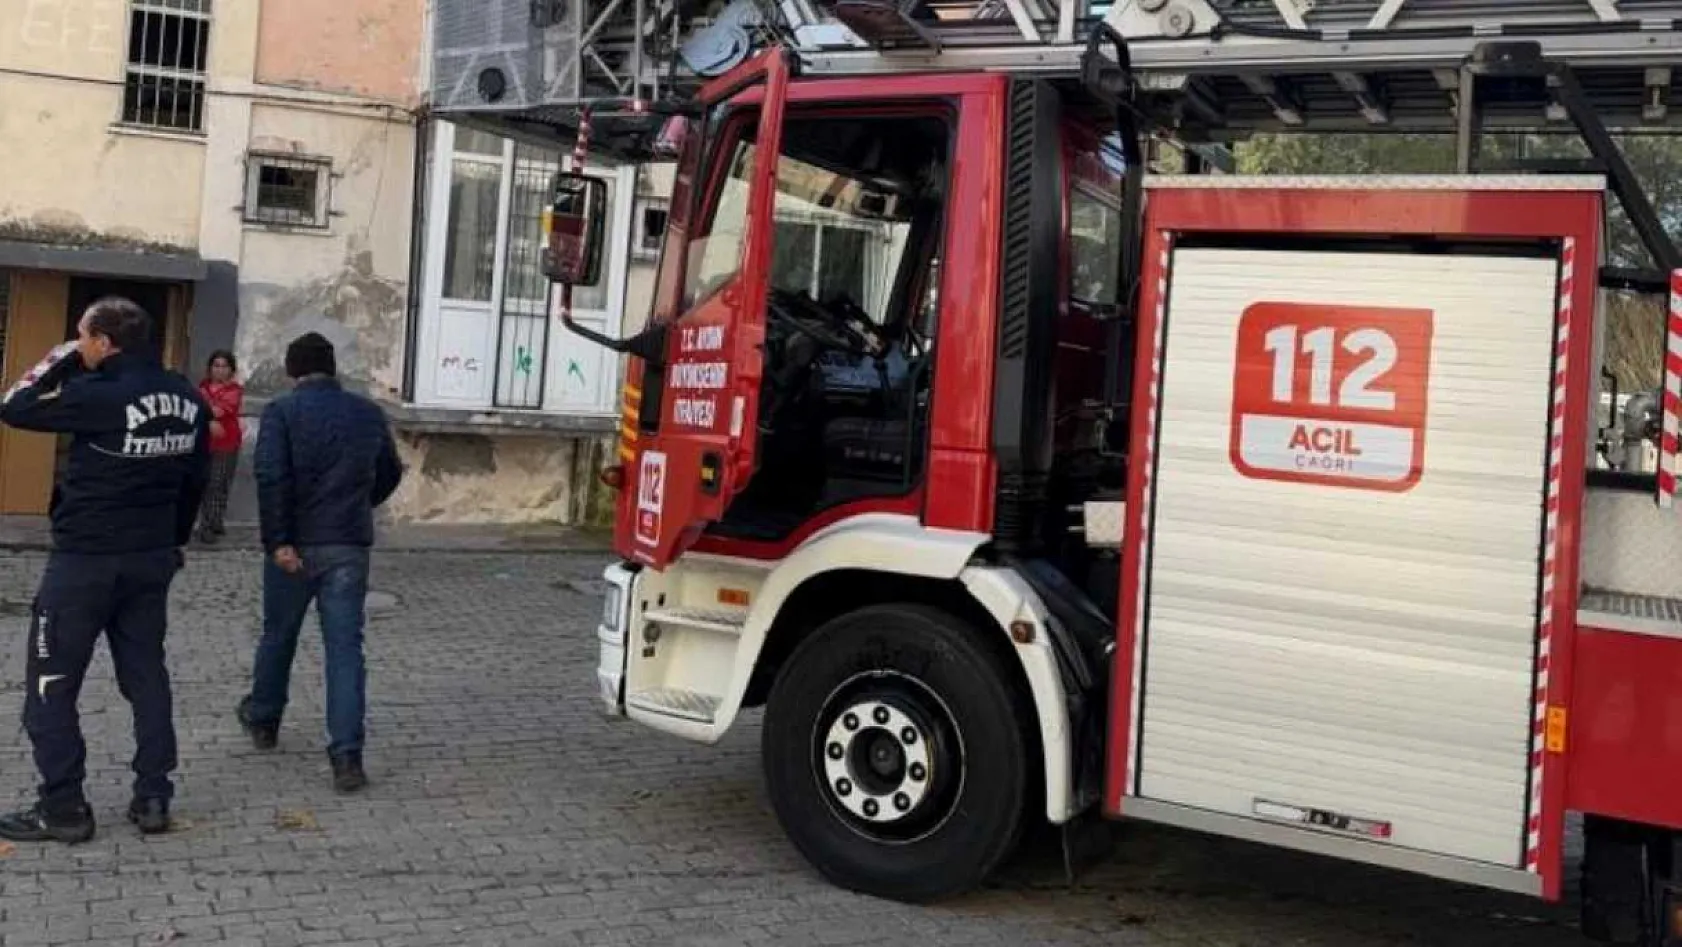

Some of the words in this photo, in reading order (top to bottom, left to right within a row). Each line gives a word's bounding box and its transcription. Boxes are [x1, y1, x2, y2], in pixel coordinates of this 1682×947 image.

[1264, 325, 1398, 410] 112
[125, 392, 199, 430] AYDIN
[641, 462, 661, 504] 112
